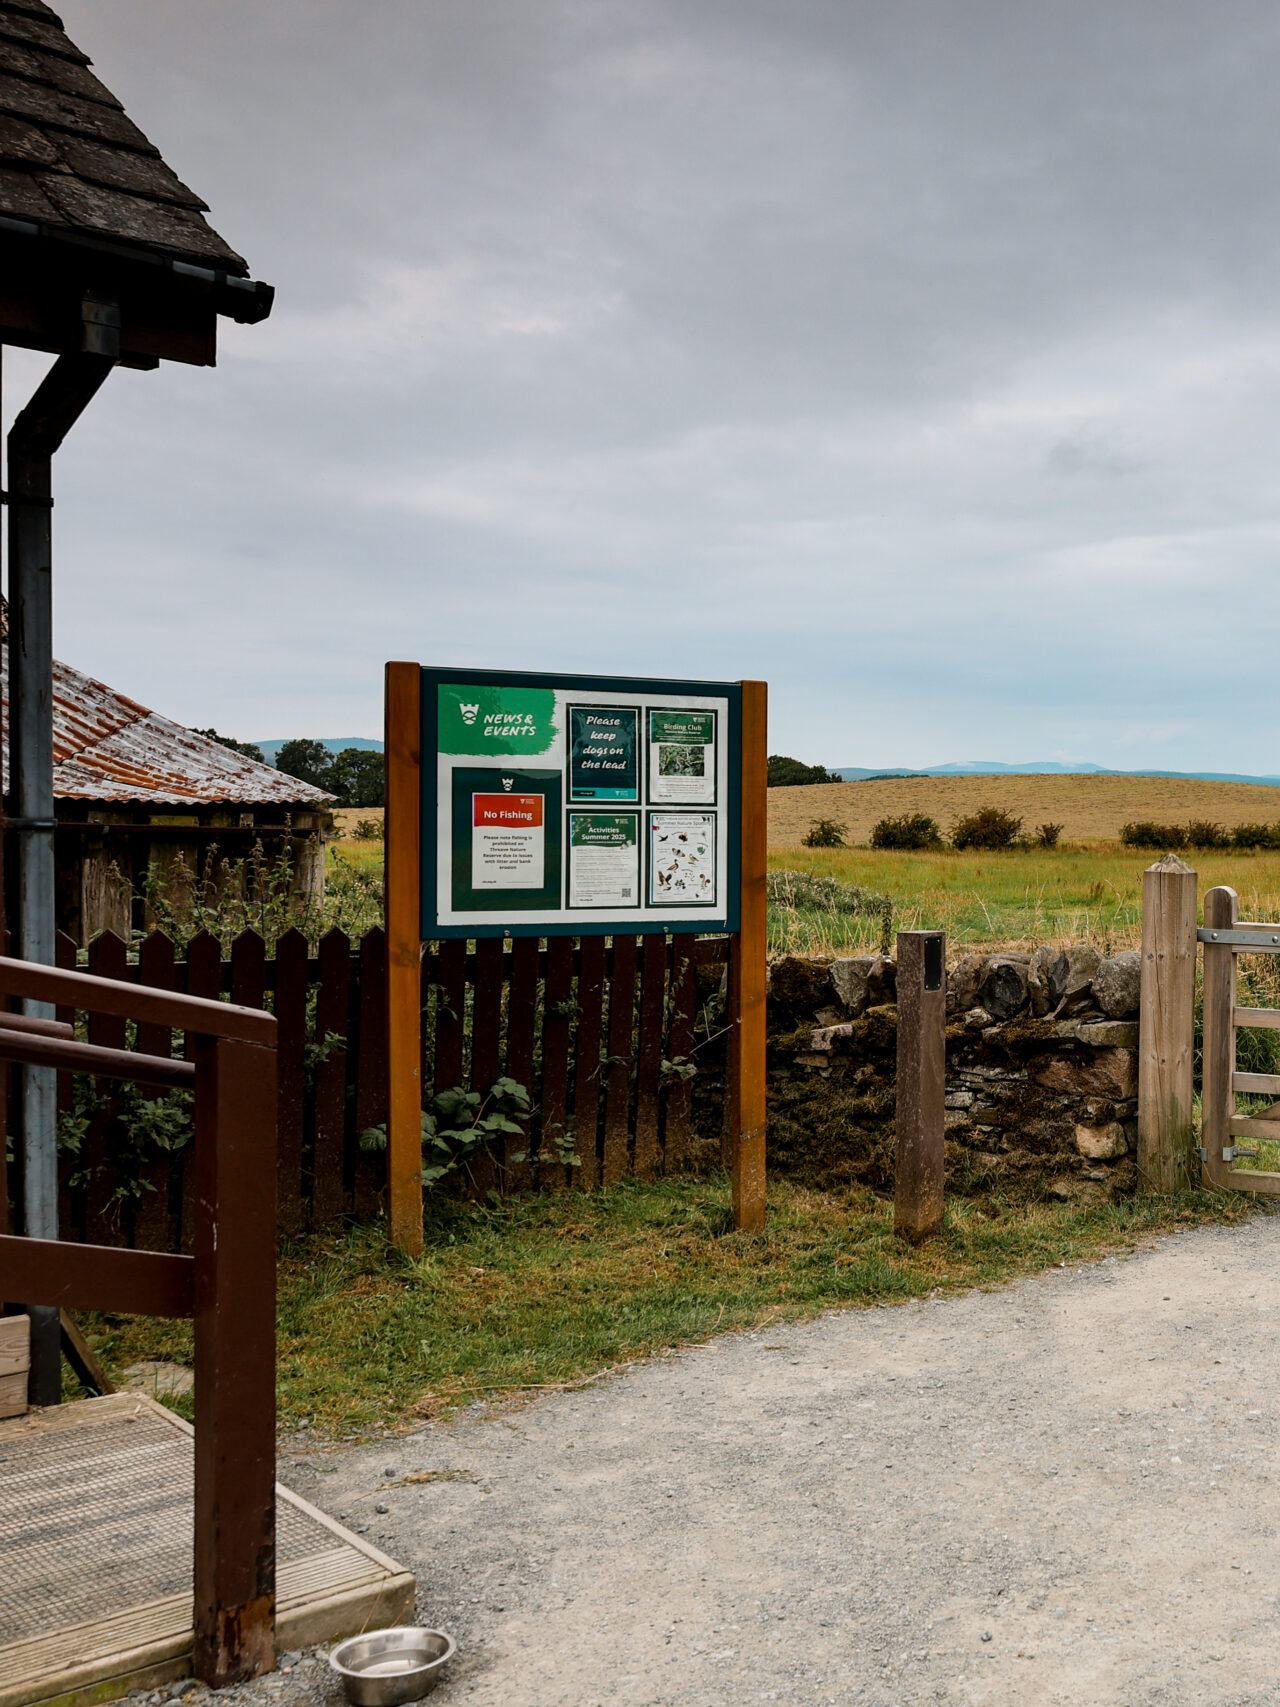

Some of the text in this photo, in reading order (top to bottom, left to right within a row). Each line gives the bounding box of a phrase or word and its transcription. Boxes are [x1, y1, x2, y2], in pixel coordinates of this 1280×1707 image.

[484, 713, 533, 724] NEWS &
[586, 716, 620, 725] Please
[484, 726, 536, 736] EVENTS
[590, 731, 616, 741] keep
[583, 745, 608, 757] dogs
[581, 760, 626, 769] the lead
[500, 810, 533, 820] Fishing
